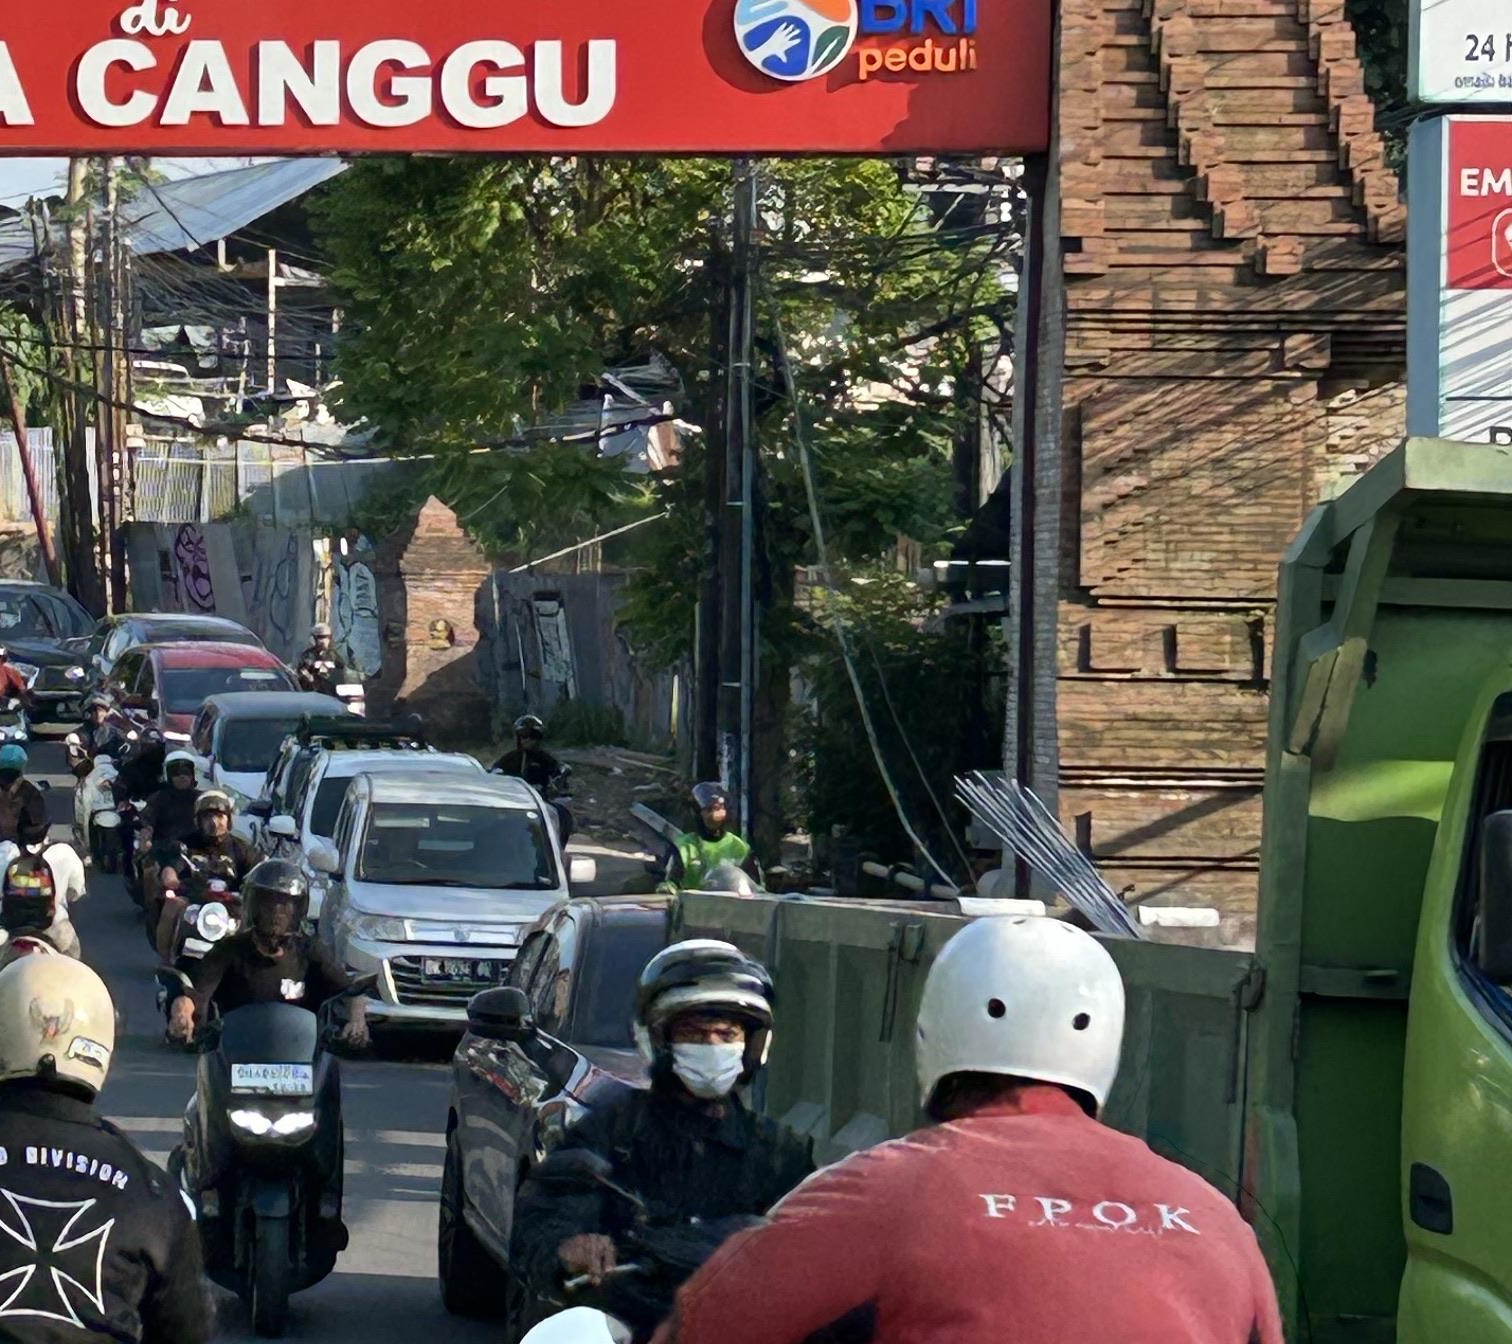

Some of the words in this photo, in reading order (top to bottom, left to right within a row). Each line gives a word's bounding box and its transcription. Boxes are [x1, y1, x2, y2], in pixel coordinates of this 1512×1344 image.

[859, 38, 977, 80] peduli
[1464, 34, 1495, 62] 24
[76, 38, 618, 129] CANGGU
[25, 1146, 129, 1190] DIVISION
